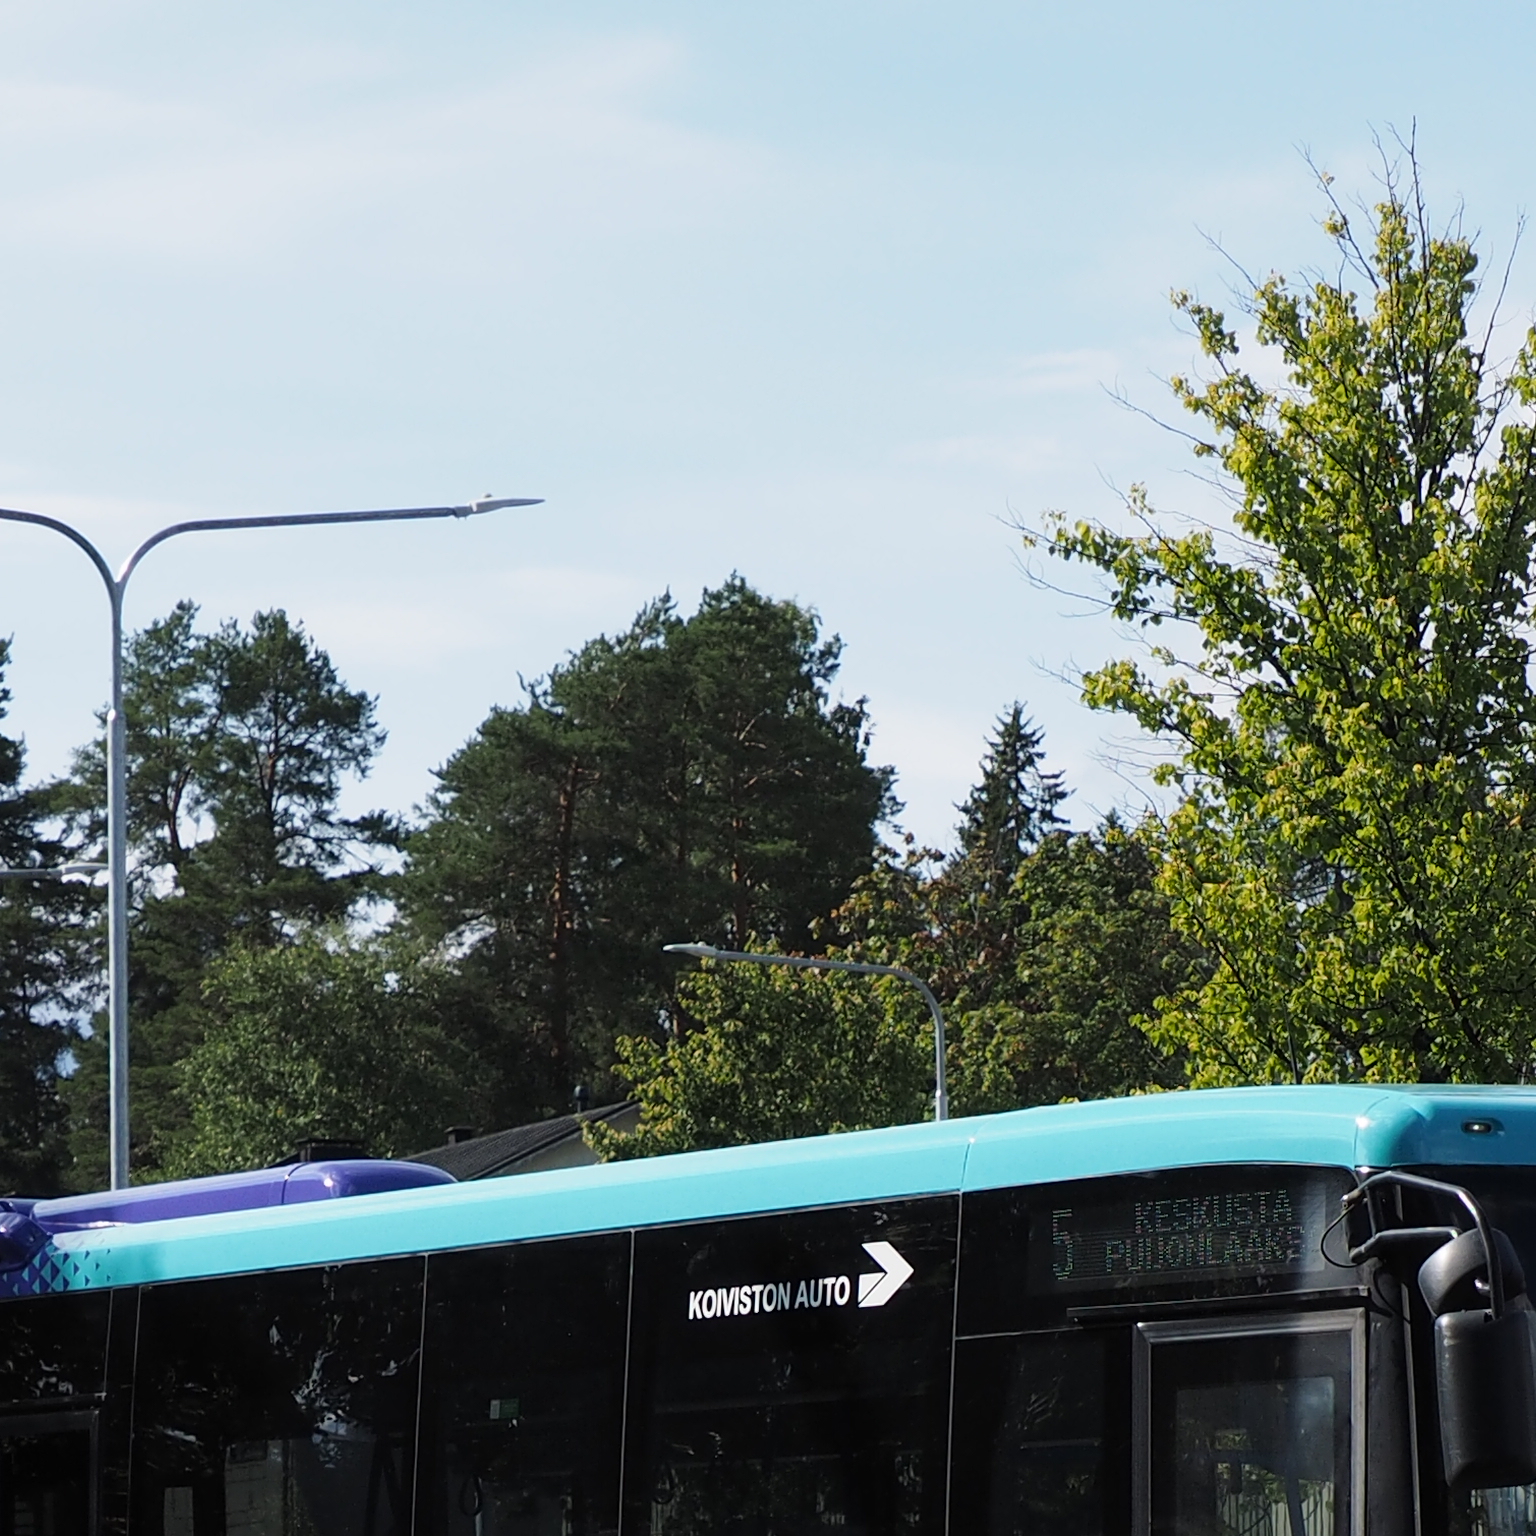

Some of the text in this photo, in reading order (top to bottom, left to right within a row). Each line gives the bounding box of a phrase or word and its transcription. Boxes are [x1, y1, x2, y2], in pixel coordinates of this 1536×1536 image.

[1134, 1189, 1292, 1234] KESKUSTA
[1052, 1208, 1074, 1281] 5
[688, 1275, 851, 1320] KOIVISTON AUTO
